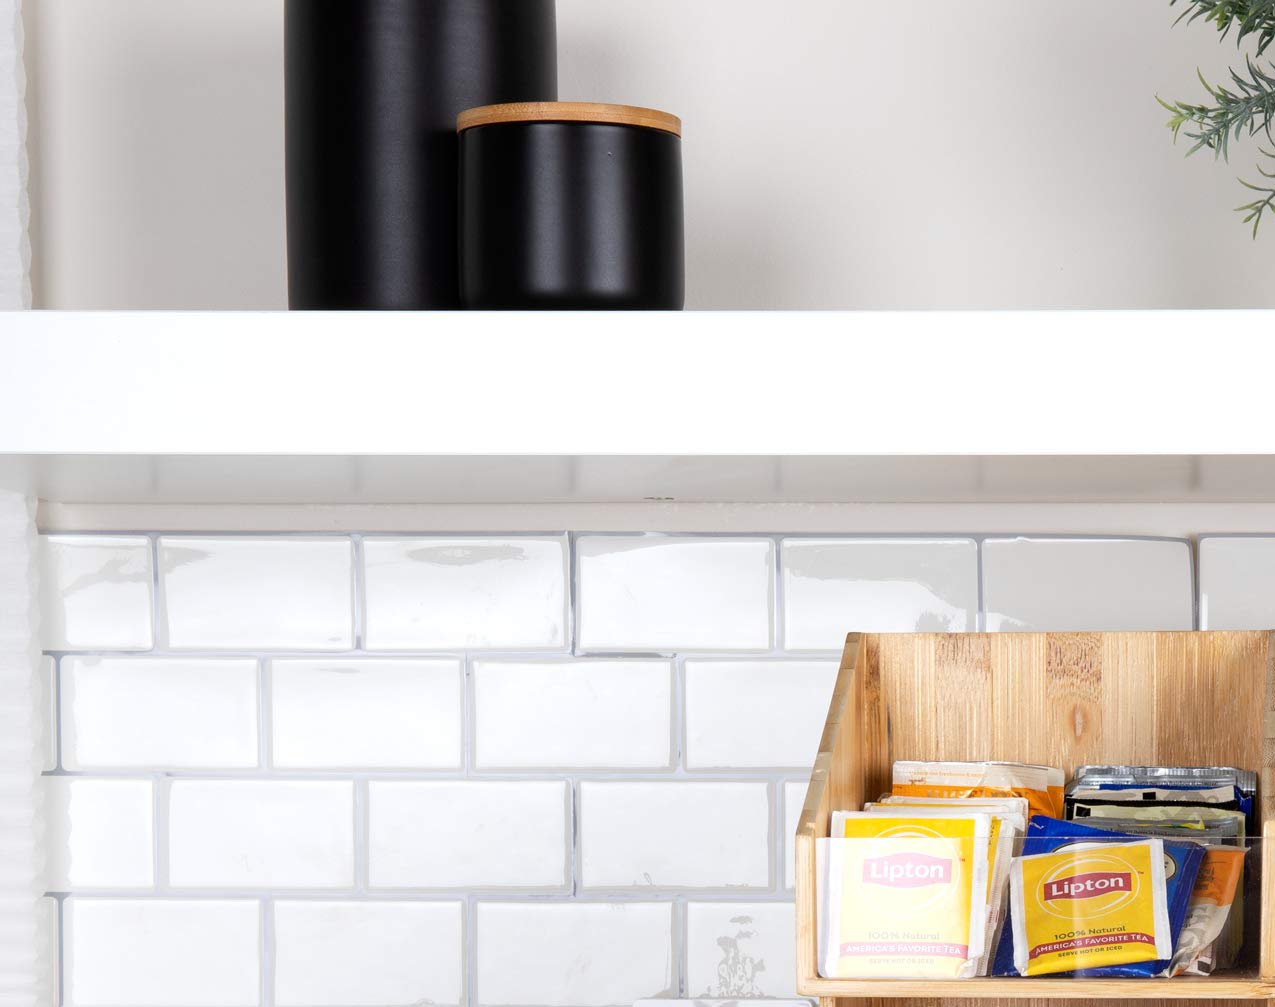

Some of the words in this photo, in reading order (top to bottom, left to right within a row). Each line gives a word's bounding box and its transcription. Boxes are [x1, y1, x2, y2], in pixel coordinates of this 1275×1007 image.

[870, 861, 944, 882] Lipton
[1051, 877, 1124, 896] Lipton
[868, 931, 900, 940] 100%
[902, 931, 940, 940] Natural
[1054, 929, 1086, 940] 100%
[1088, 925, 1126, 936] Natural
[846, 944, 897, 953] AMERICA'S
[900, 944, 942, 953] FAVORITE
[943, 944, 961, 954] TEA
[1035, 940, 1083, 955] AMERICA'S
[1085, 935, 1129, 945] FAVORITE
[1131, 933, 1149, 942] TEA
[1058, 950, 1079, 958] SERVE
